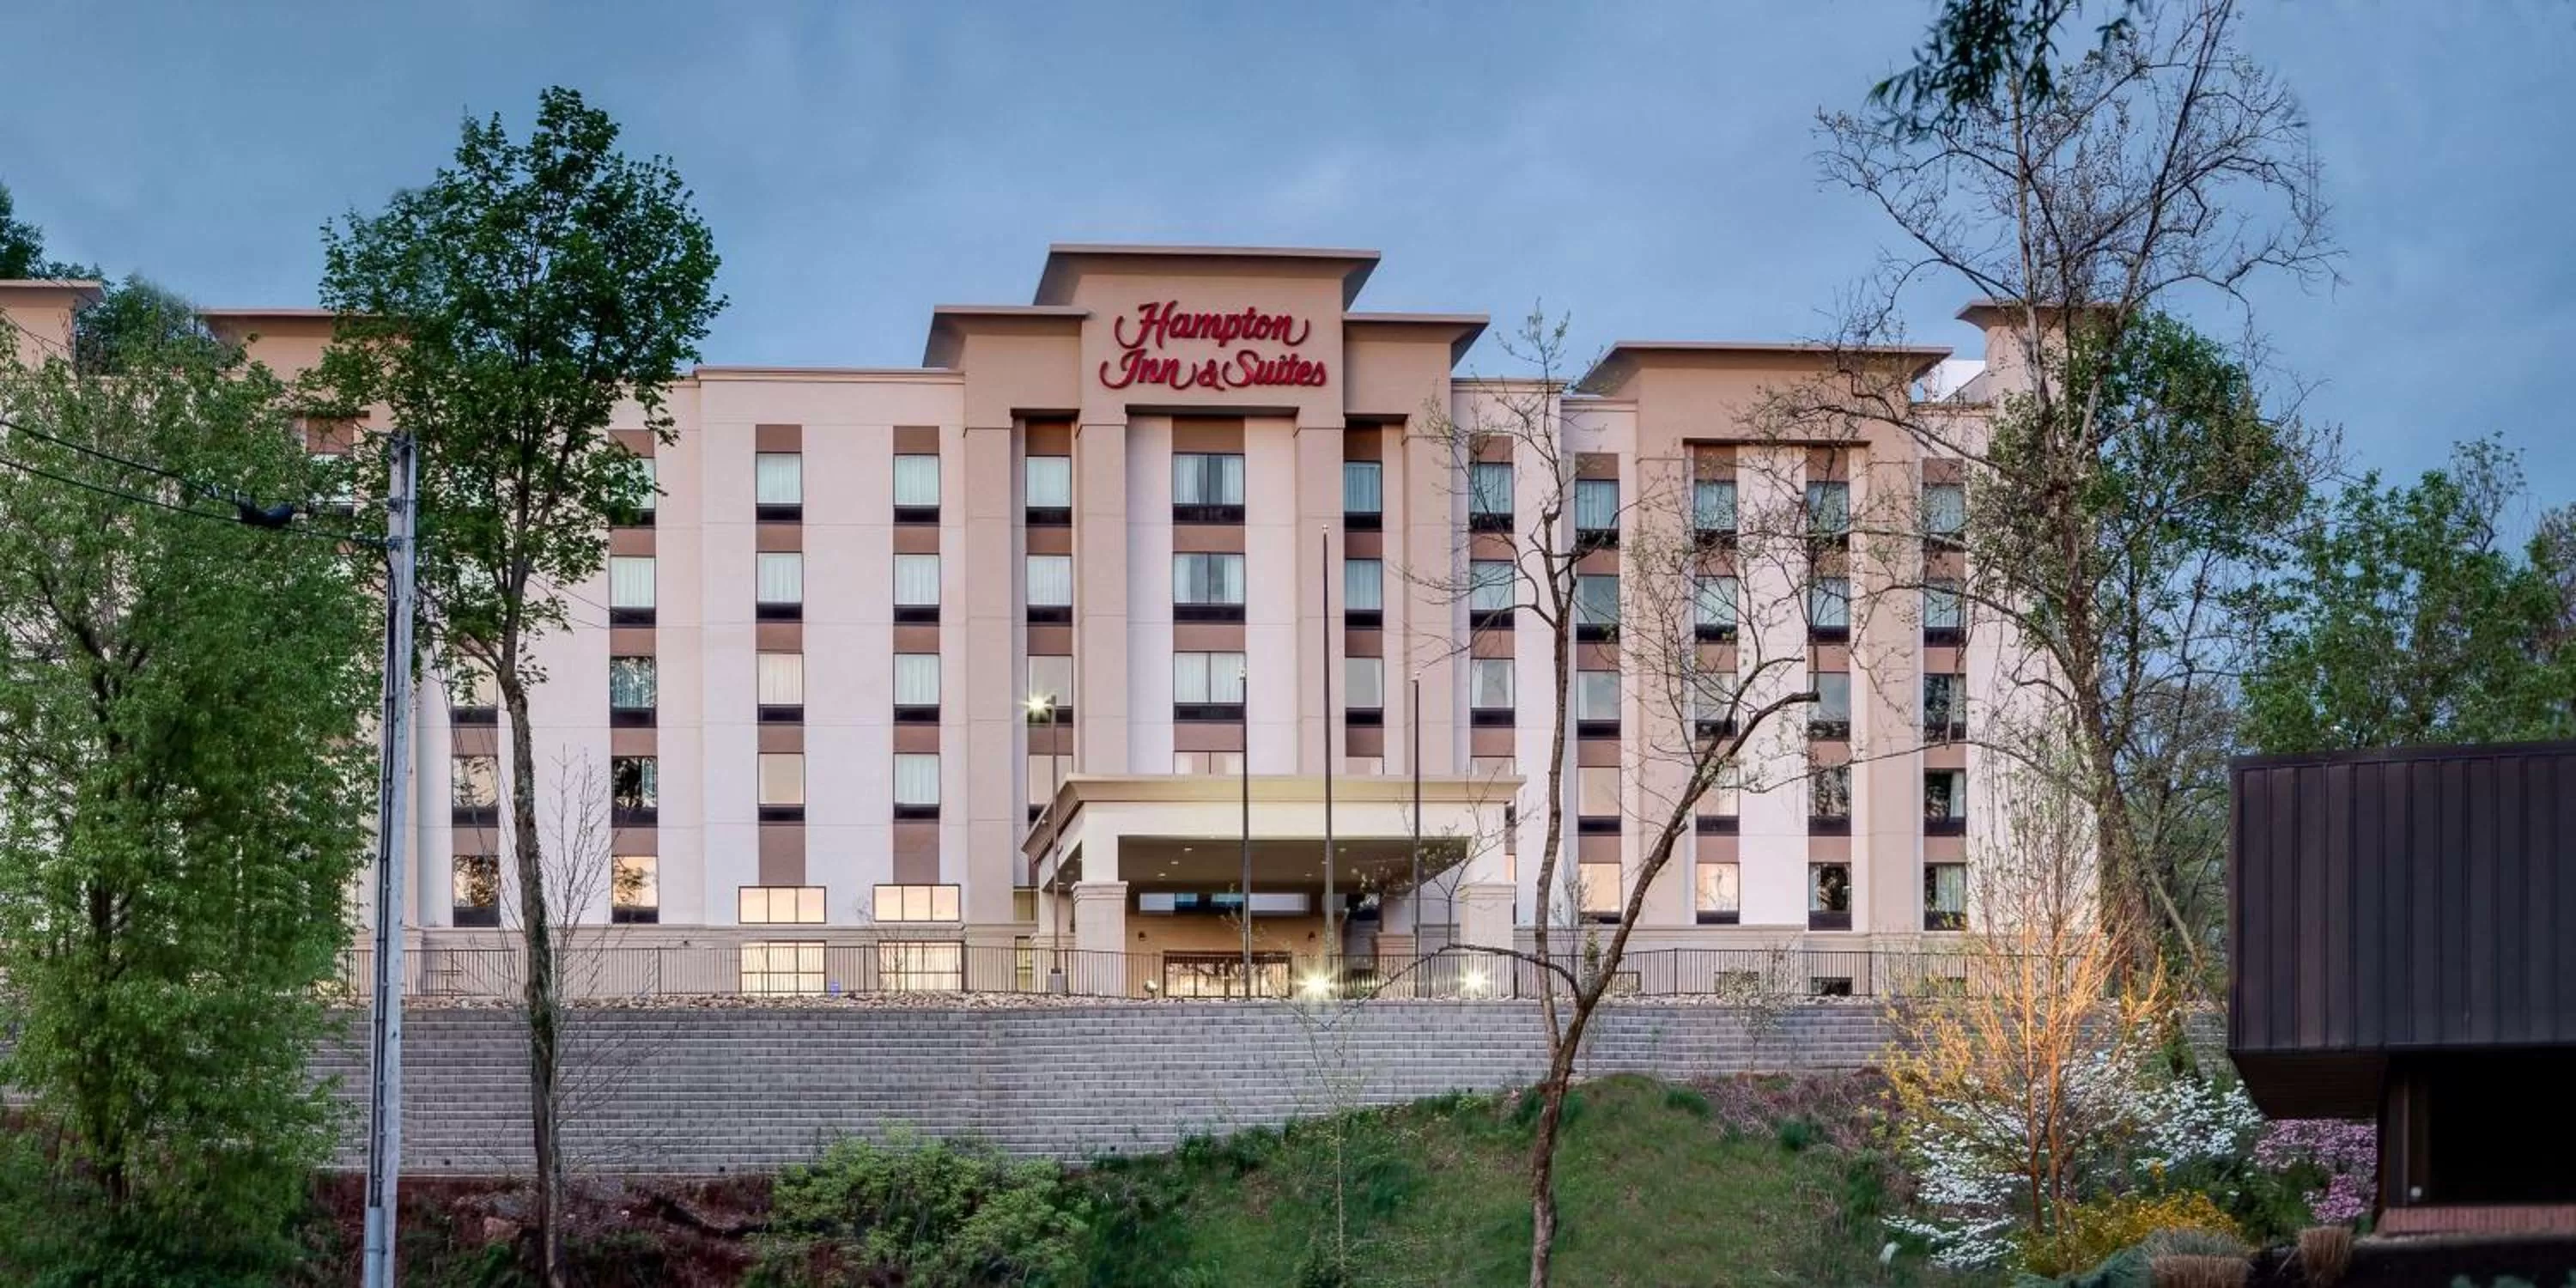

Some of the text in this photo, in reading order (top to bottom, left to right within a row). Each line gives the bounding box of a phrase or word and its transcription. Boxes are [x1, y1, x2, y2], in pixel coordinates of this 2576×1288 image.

[1115, 301, 1309, 349] Hampton
[1099, 349, 1327, 390] Inn & Suites
